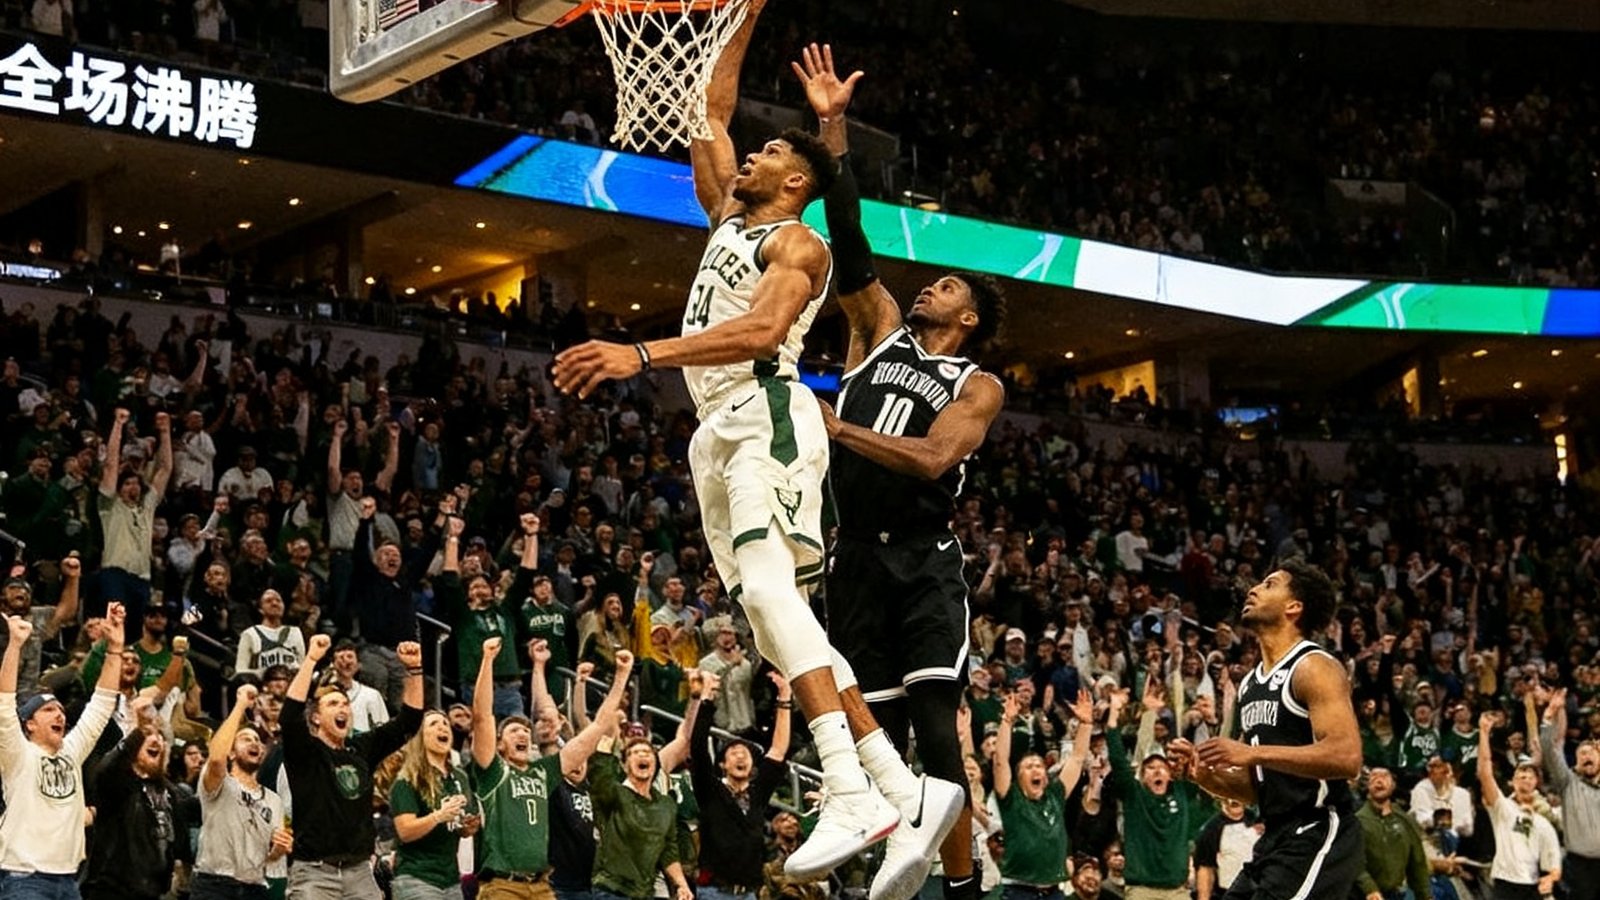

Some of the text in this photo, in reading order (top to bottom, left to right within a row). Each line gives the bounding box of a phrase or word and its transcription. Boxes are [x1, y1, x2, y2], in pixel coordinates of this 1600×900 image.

[0, 42, 258, 149] 全场沸腾
[686, 284, 715, 328] 34
[872, 393, 915, 437] 10
